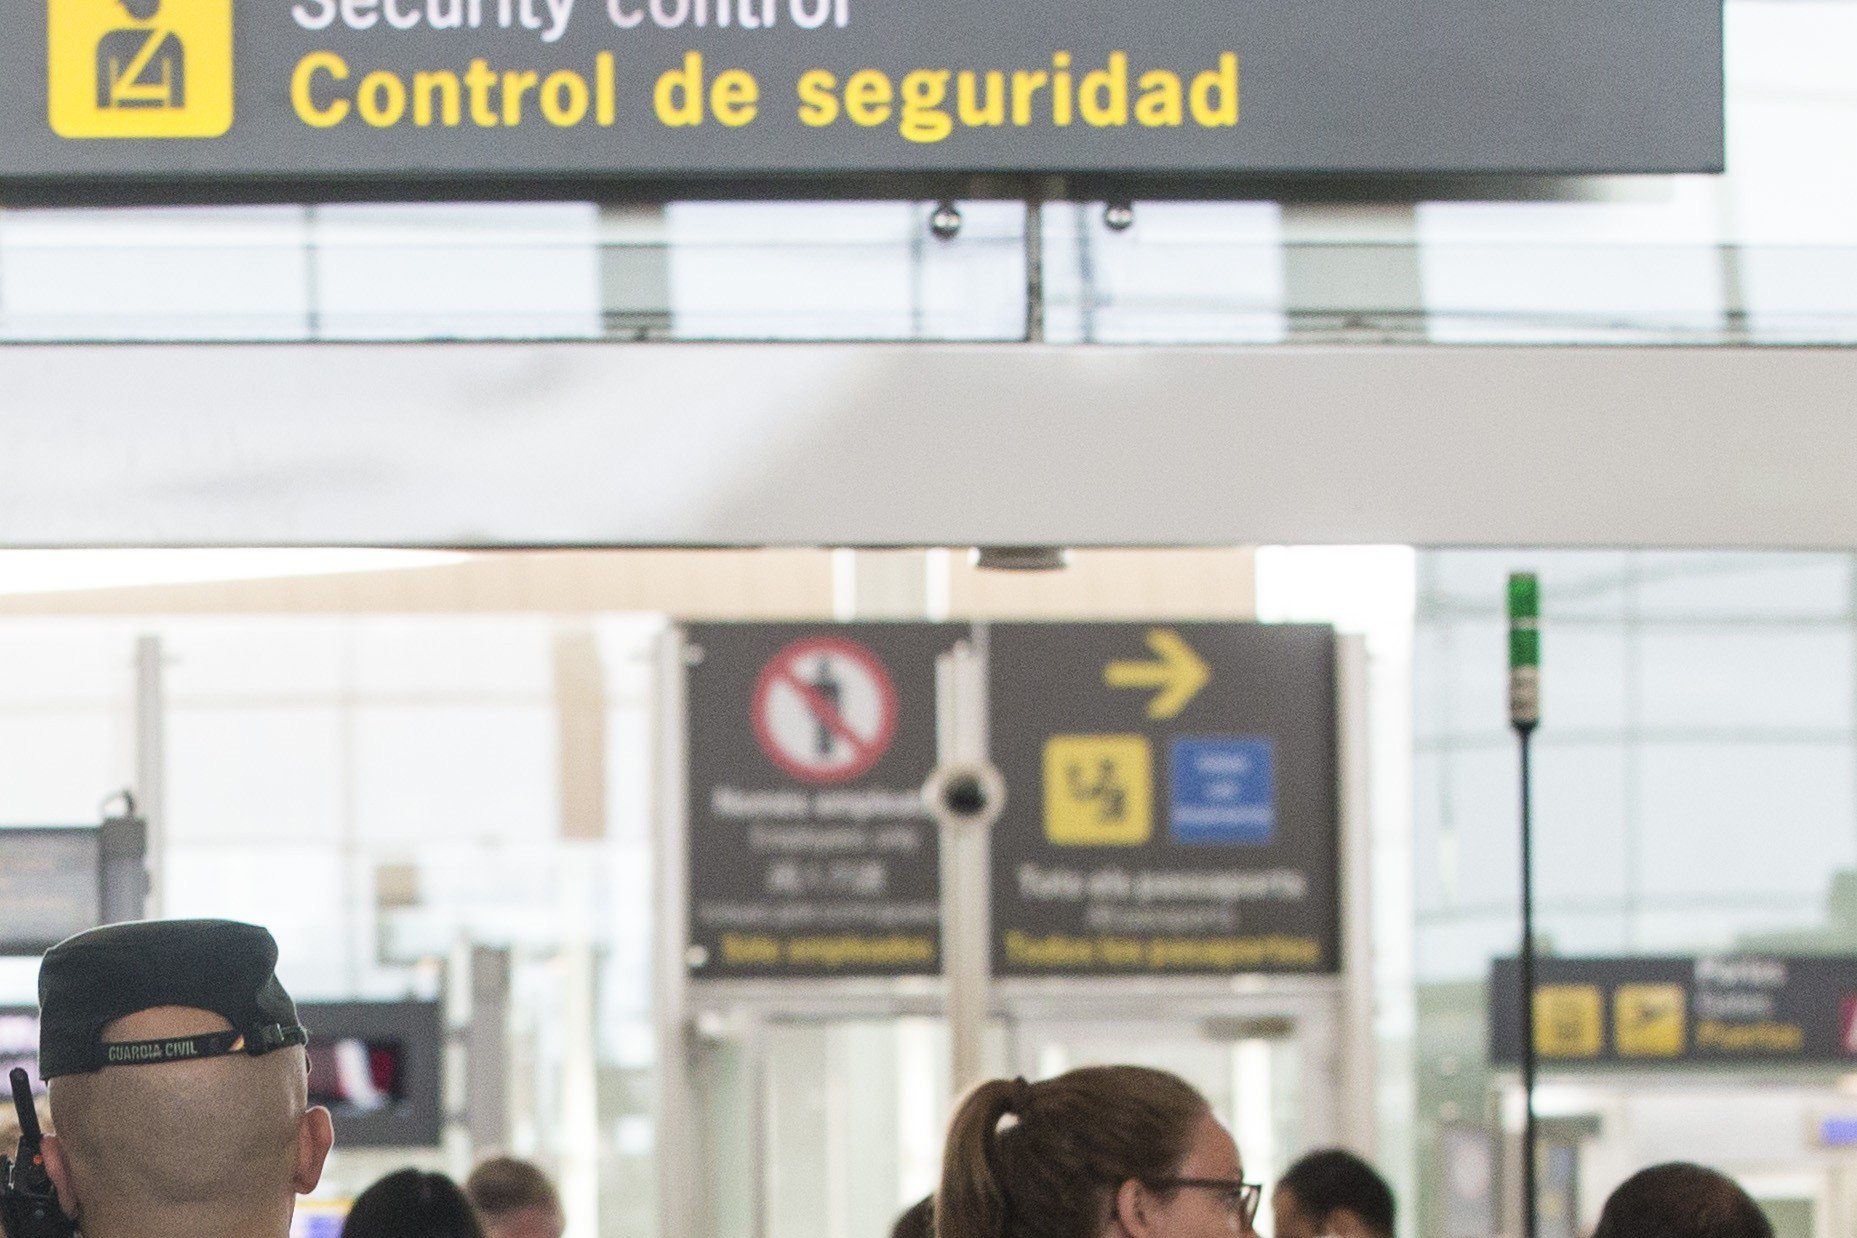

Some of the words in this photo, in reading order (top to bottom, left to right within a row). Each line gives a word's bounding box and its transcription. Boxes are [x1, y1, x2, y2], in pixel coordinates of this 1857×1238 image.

[290, 51, 616, 128] Control
[653, 50, 759, 127] de
[796, 50, 1239, 144] seguridad
[108, 1044, 163, 1061] GUARDIA
[165, 1041, 198, 1057] CIVIL
